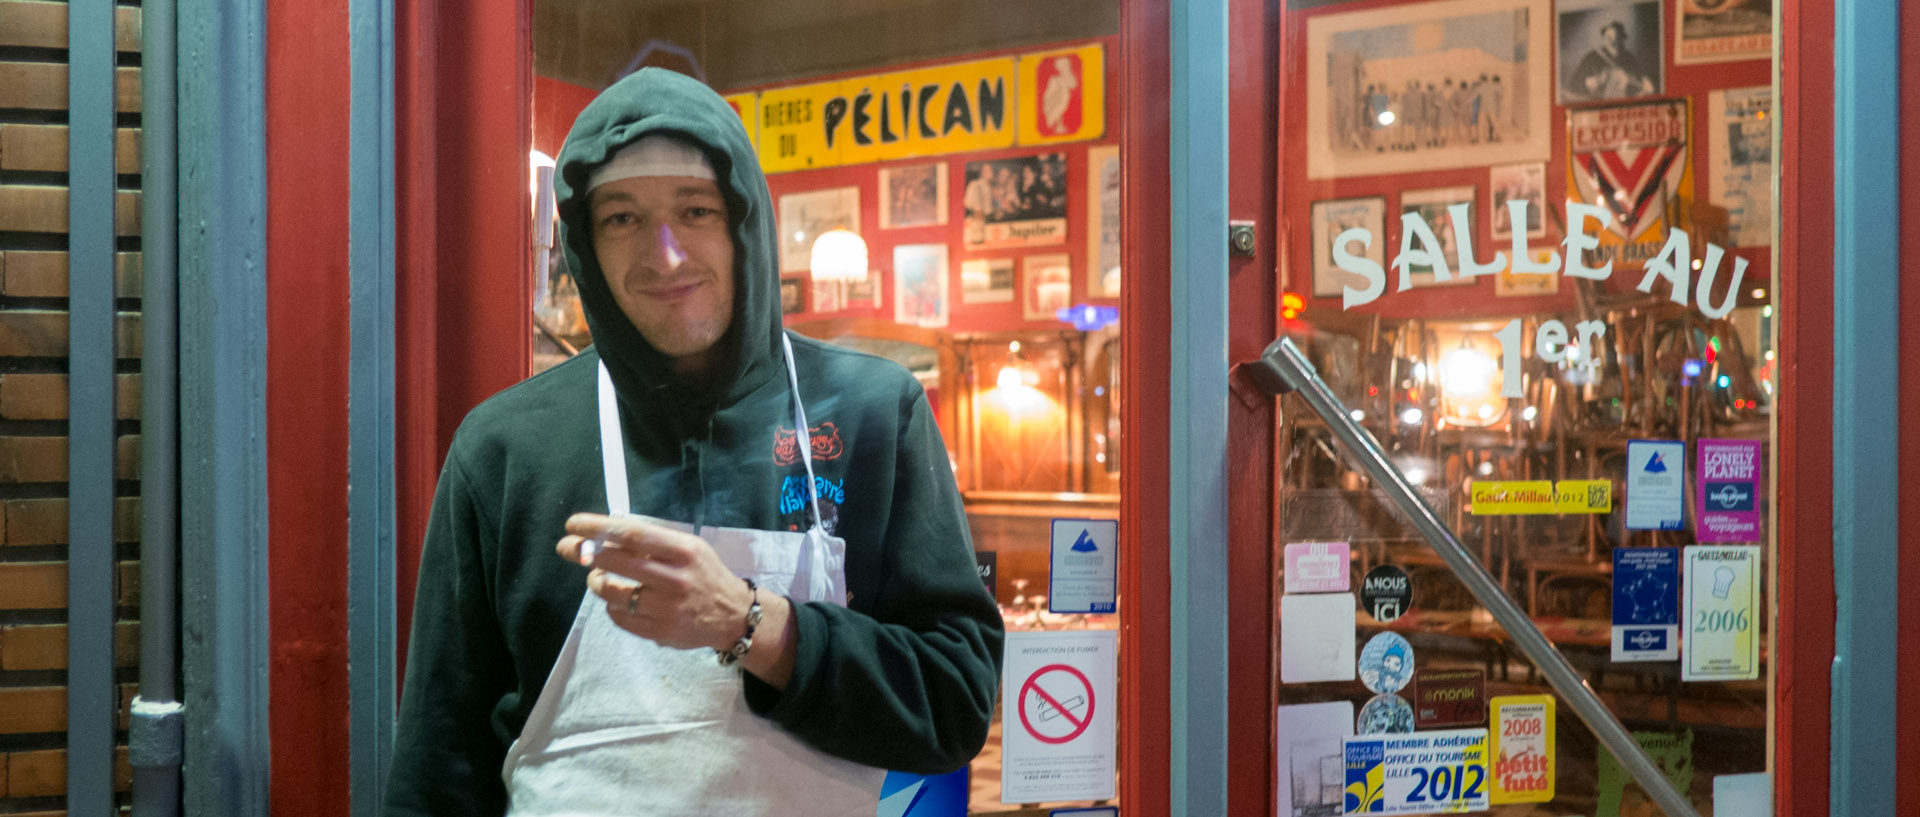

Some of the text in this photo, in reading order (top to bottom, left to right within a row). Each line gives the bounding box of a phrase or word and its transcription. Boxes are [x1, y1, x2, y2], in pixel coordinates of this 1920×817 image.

[823, 75, 1005, 150] PÉLICAN
[1332, 199, 1750, 320] SALLE AU
[1493, 318, 1607, 398] 1er
[1705, 452, 1754, 465] LONELY
[1705, 465, 1754, 479] PLANET
[1374, 603, 1400, 622] ICI
[1694, 608, 1748, 633] 2006
[1022, 645, 1098, 655] INTERDICTION DE FUMER
[1503, 718, 1541, 736] 2008
[1346, 745, 1383, 754] OFFICE DU
[1385, 735, 1486, 749] MEMBRE ADHÉRENT
[1346, 753, 1383, 762] TOURISME
[1346, 761, 1366, 769] LILLE
[1385, 751, 1482, 765] OFFICE DU TOURISME
[1386, 767, 1410, 778] LILLE
[1495, 753, 1548, 779] petit
[1406, 764, 1485, 803] 2012
[1503, 773, 1548, 792] futé
